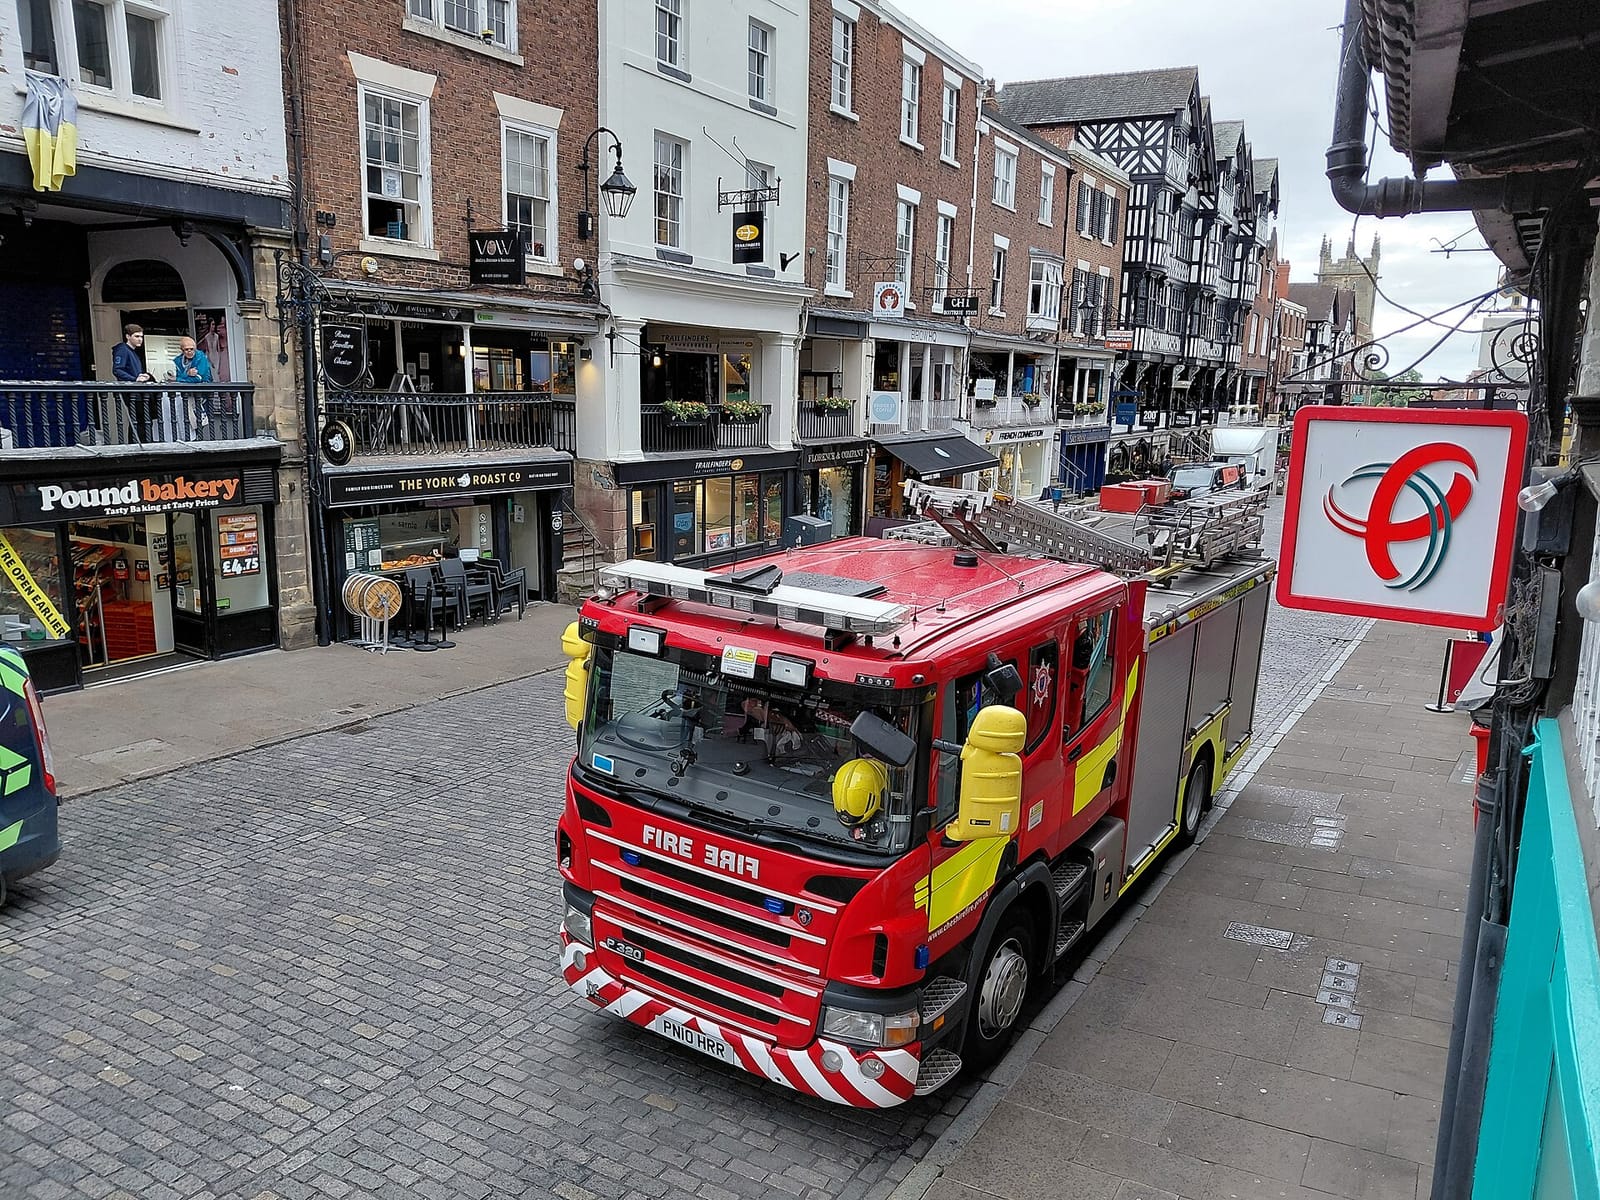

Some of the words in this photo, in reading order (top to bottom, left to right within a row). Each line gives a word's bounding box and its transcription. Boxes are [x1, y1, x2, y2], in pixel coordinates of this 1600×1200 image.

[476, 239, 513, 255] VOW
[999, 432, 1017, 440] FRENCH
[1017, 430, 1043, 438] CONNECTION
[695, 460, 731, 469] TRAILFINDERS
[808, 452, 835, 462] FLORENCE
[399, 479, 423, 491] THE
[425, 476, 456, 489] YORK
[473, 473, 507, 486] ROAST
[104, 506, 129, 516] Tasty
[130, 503, 161, 513] Baking
[162, 502, 171, 510] at
[172, 500, 194, 510] Tasty
[195, 499, 219, 507] Prices
[222, 558, 259, 574] £4.75
[0, 541, 16, 568] E'RE
[12, 567, 35, 596] OPEN
[31, 594, 66, 637] EARLIER
[643, 824, 693, 859] FIRE
[617, 943, 642, 960] 320
[663, 1019, 693, 1044] PN10
[697, 1034, 725, 1058] HRR
